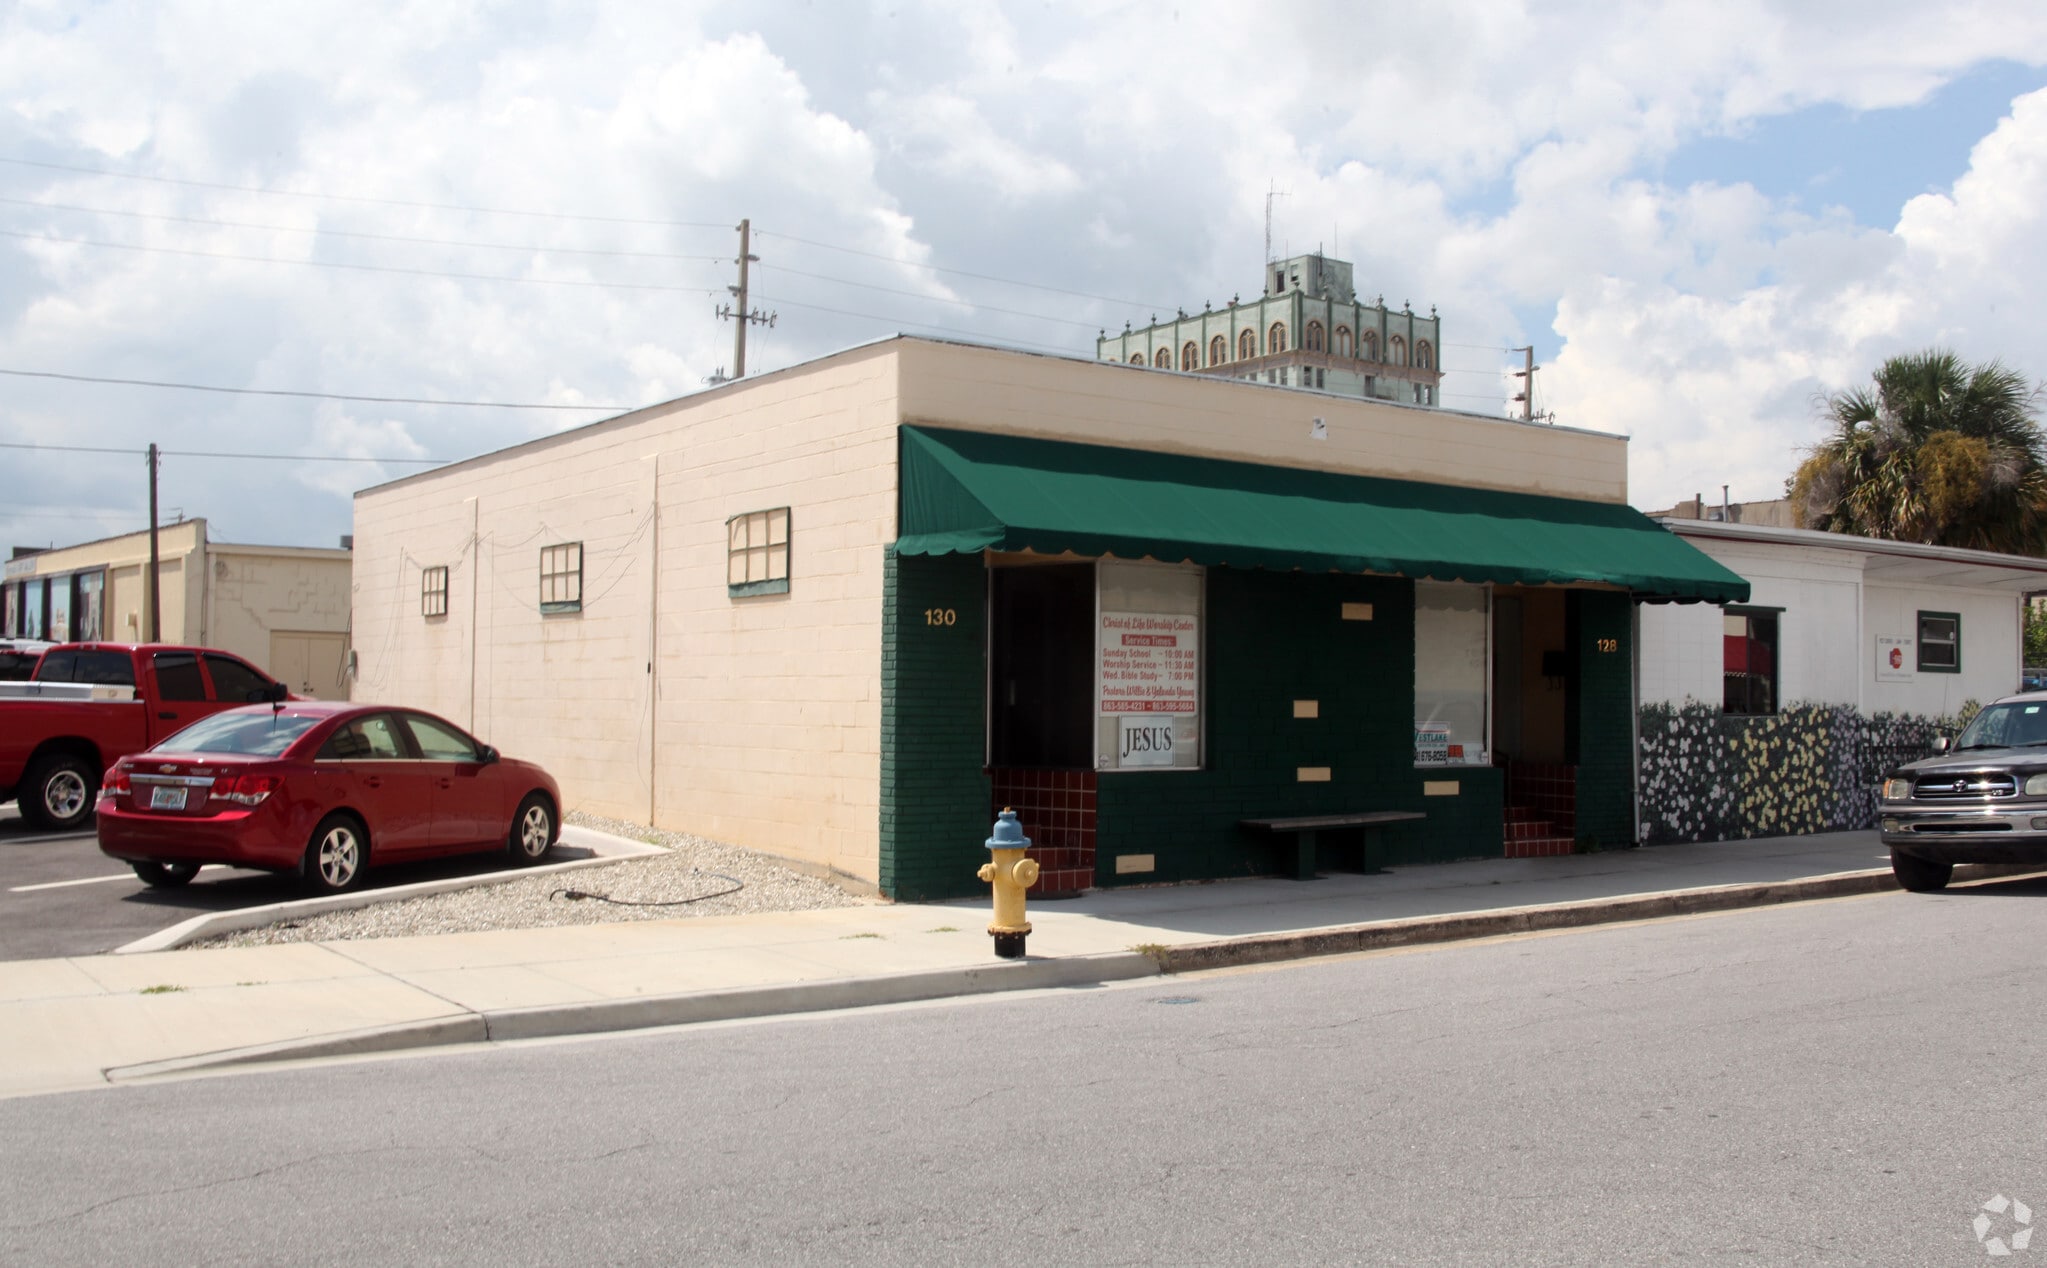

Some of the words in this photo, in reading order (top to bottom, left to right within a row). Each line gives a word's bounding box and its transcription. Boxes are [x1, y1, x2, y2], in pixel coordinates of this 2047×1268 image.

[924, 608, 956, 626] 130
[1103, 616, 1123, 629] Christ
[1124, 618, 1131, 630] of
[1132, 617, 1146, 630] Life
[1146, 618, 1173, 632] Worship
[1173, 619, 1194, 631] Center
[1125, 635, 1150, 645] Service
[1597, 638, 1617, 653] 128
[1103, 648, 1128, 660] Sunday
[1129, 649, 1151, 658] School
[1165, 650, 1182, 658] 10:00
[1183, 650, 1194, 659] AM
[1103, 660, 1131, 670] Worship
[1132, 660, 1157, 669] Service
[1165, 661, 1182, 669] 11:30
[1183, 661, 1194, 669] AM
[1103, 671, 1120, 679] Wed.
[1121, 671, 1138, 680] Bible
[1139, 671, 1158, 682] Study
[1168, 672, 1183, 680] 7:00
[1183, 672, 1194, 680] PM
[1103, 685, 1126, 696] Pastors
[1126, 685, 1145, 696] Willie
[1145, 687, 1151, 696] &
[1151, 685, 1176, 699] Yolanda
[1176, 686, 1195, 699] Young
[1122, 727, 1172, 758] JESUS
